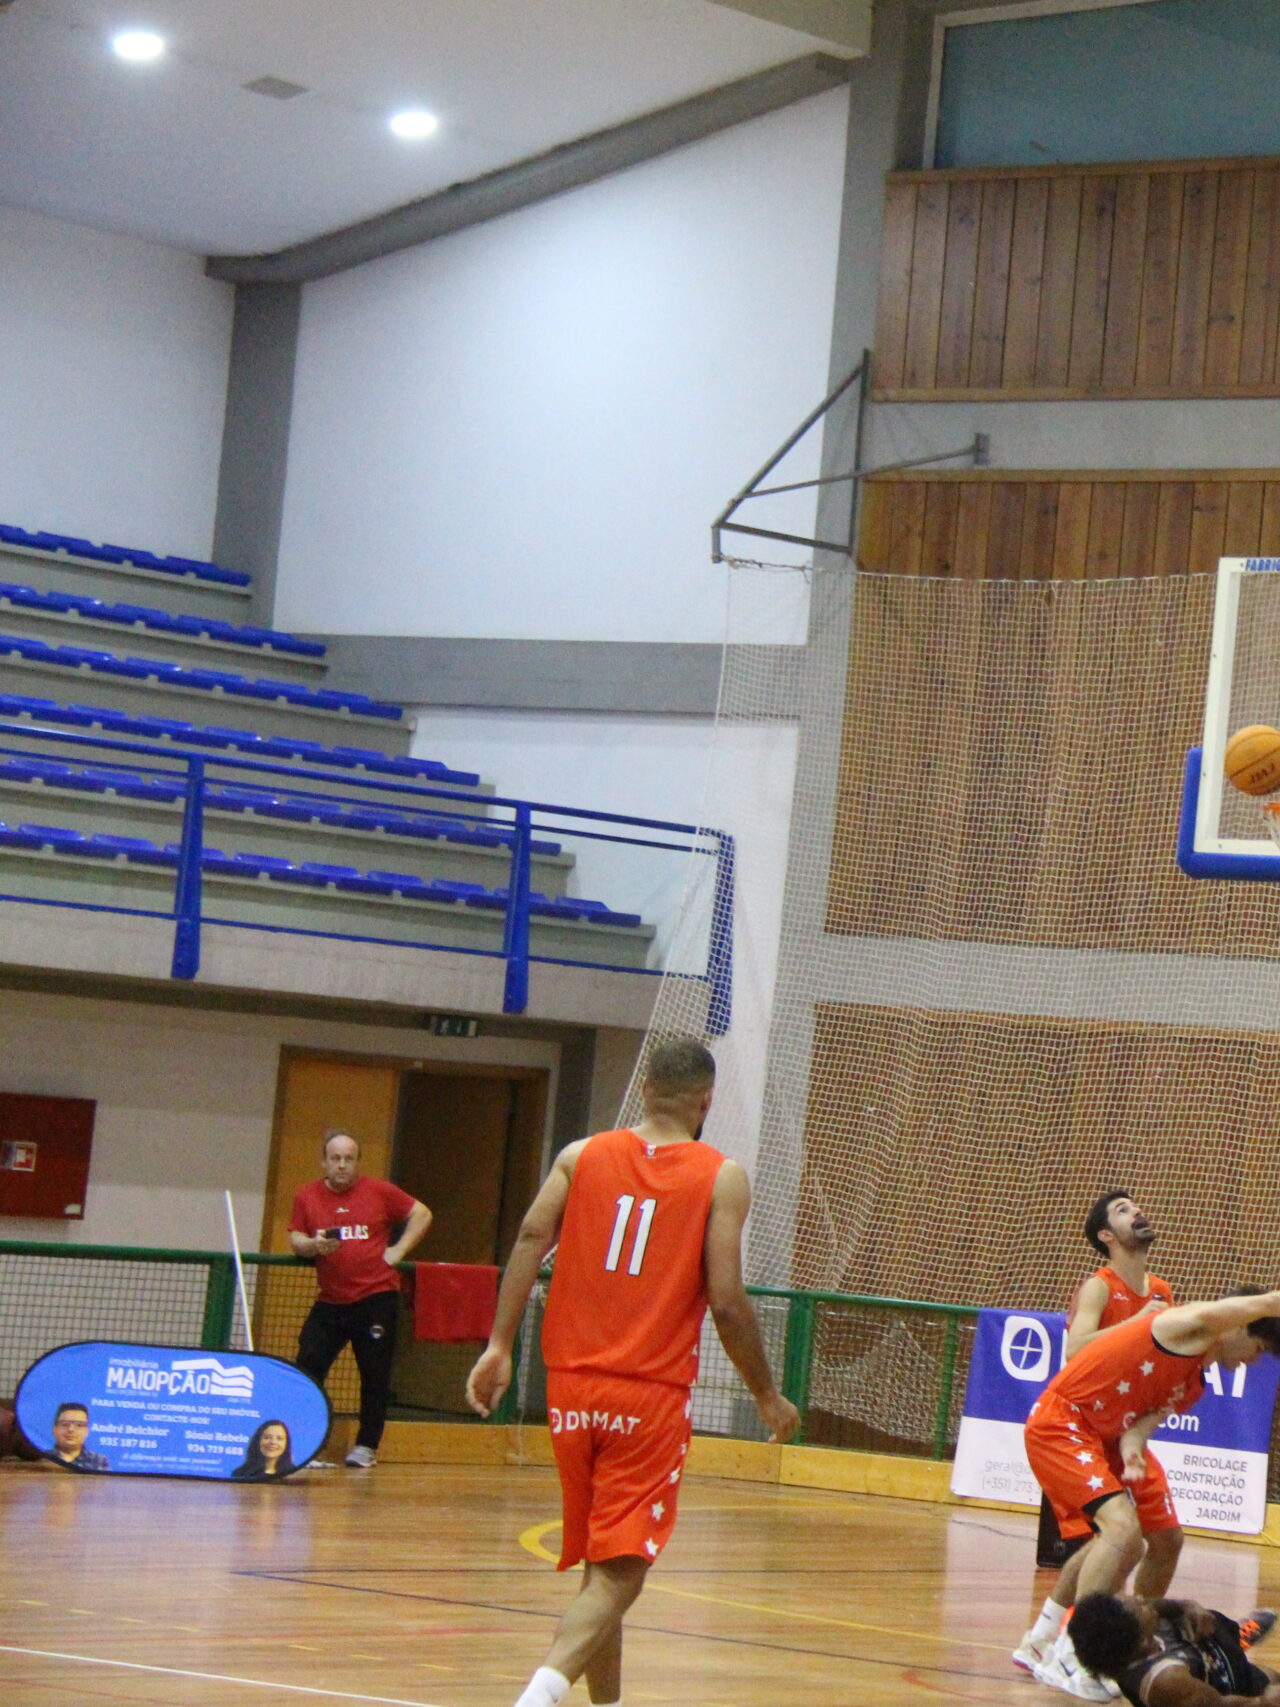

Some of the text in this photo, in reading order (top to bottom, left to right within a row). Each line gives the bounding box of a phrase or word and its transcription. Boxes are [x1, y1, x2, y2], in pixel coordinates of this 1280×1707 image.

[604, 1193, 657, 1276] 11
[106, 1366, 211, 1396] MAIOPÇÃO
[91, 1398, 115, 1408] PARA
[116, 1400, 146, 1410] VENDA
[147, 1403, 160, 1411] OU
[161, 1403, 198, 1414] COMPRA
[199, 1406, 211, 1415] DO
[212, 1407, 227, 1416] SEU
[91, 1423, 170, 1437] André Belchior
[185, 1429, 249, 1443] Sónia Rebelo
[100, 1436, 118, 1447] 935
[120, 1437, 138, 1448] 187
[187, 1443, 205, 1454] 934
[1183, 1454, 1248, 1472] BRICOLAGE
[1166, 1469, 1246, 1490] CONSTRUÇÃO
[1170, 1486, 1243, 1508] DECORAÇÃO
[1195, 1507, 1241, 1523] JARDIM
